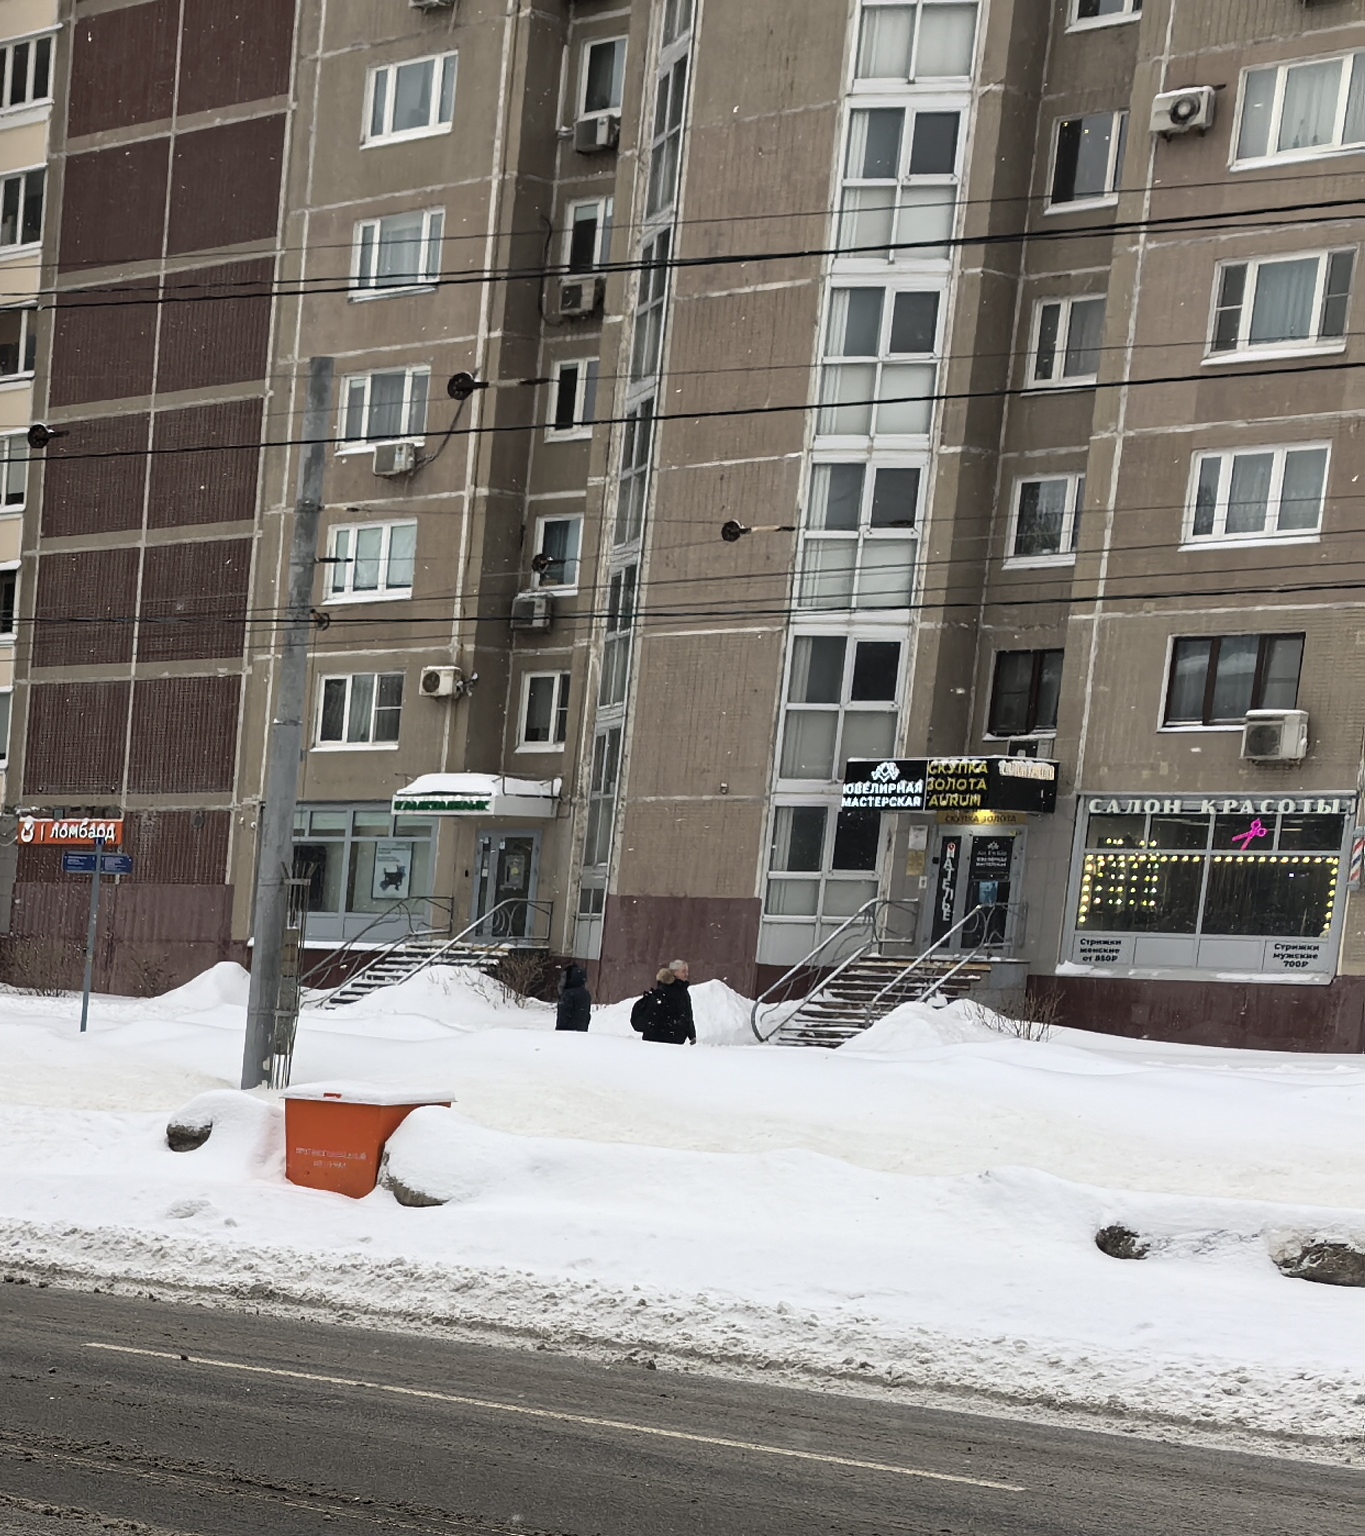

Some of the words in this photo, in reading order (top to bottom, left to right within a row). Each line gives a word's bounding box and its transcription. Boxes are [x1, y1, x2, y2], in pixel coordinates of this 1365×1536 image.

[927, 760, 988, 774] СКУПКА
[842, 780, 923, 794] ЮВЕЛИРНАЯ
[927, 777, 988, 790] ЗОЛОТА
[841, 796, 921, 807] МАСТЕРСКАЯ
[928, 794, 982, 807] AURUM
[1088, 799, 1183, 813] САЛОН
[1200, 799, 1341, 813] КРАСОТЫ
[50, 821, 116, 842] ломбард
[1080, 938, 1122, 946] Стрижки
[1274, 943, 1320, 951] Стрижки
[1273, 952, 1319, 960] мужские
